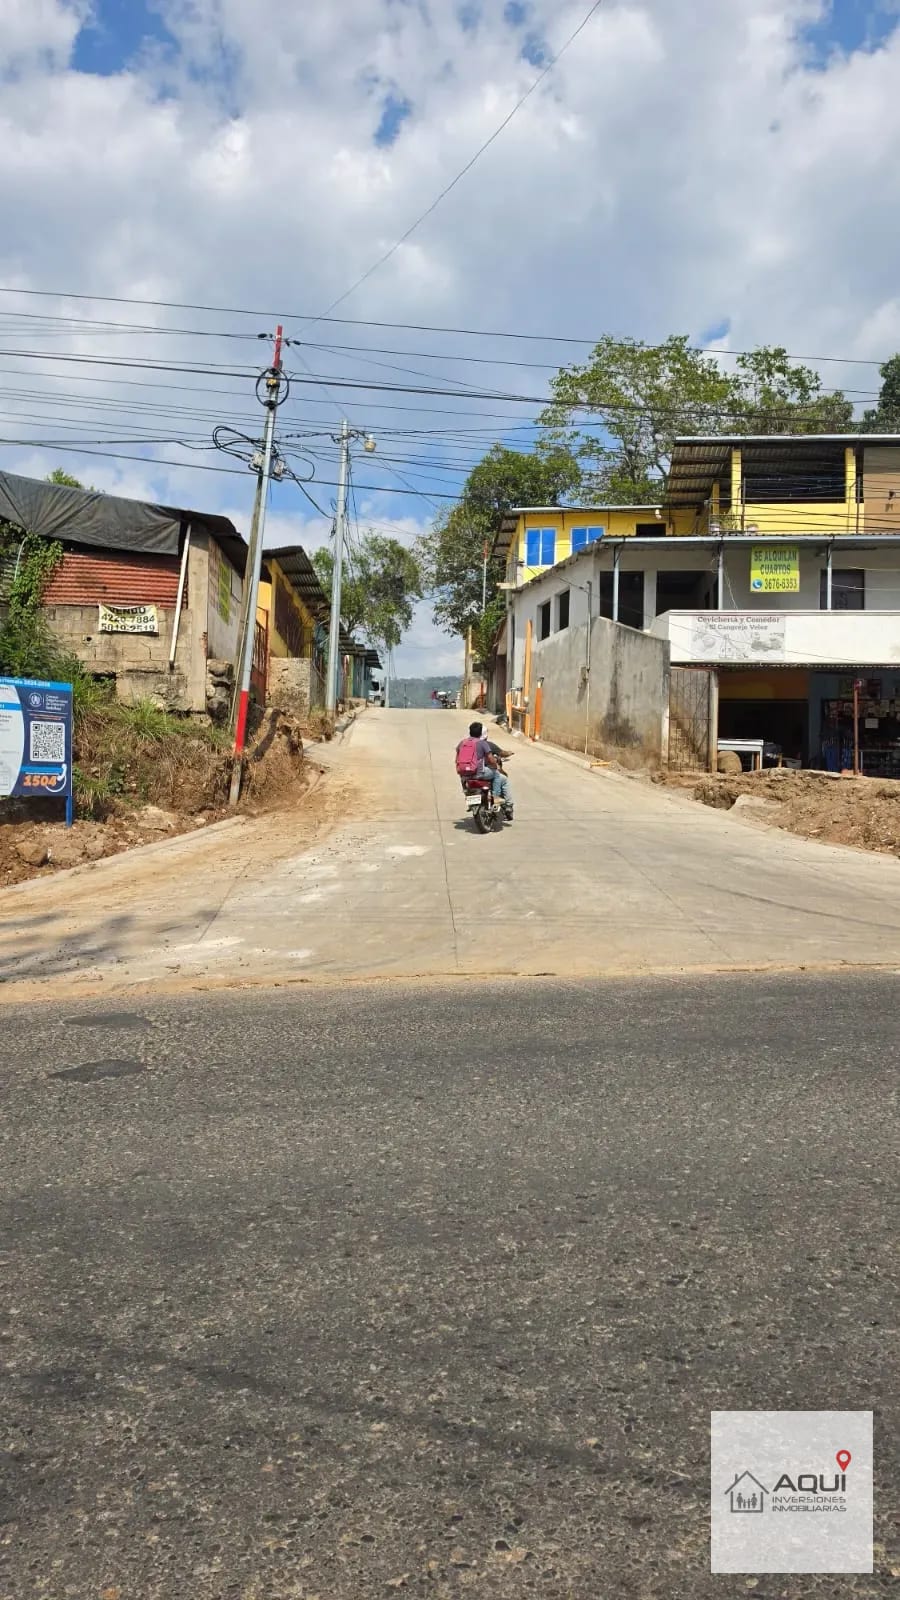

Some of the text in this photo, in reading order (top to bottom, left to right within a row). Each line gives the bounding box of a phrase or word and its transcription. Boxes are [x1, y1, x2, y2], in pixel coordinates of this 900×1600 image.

[754, 550, 797, 562] SE ALQUILAN
[760, 564, 791, 575] CUARTOS
[23, 775, 57, 787] 1504
